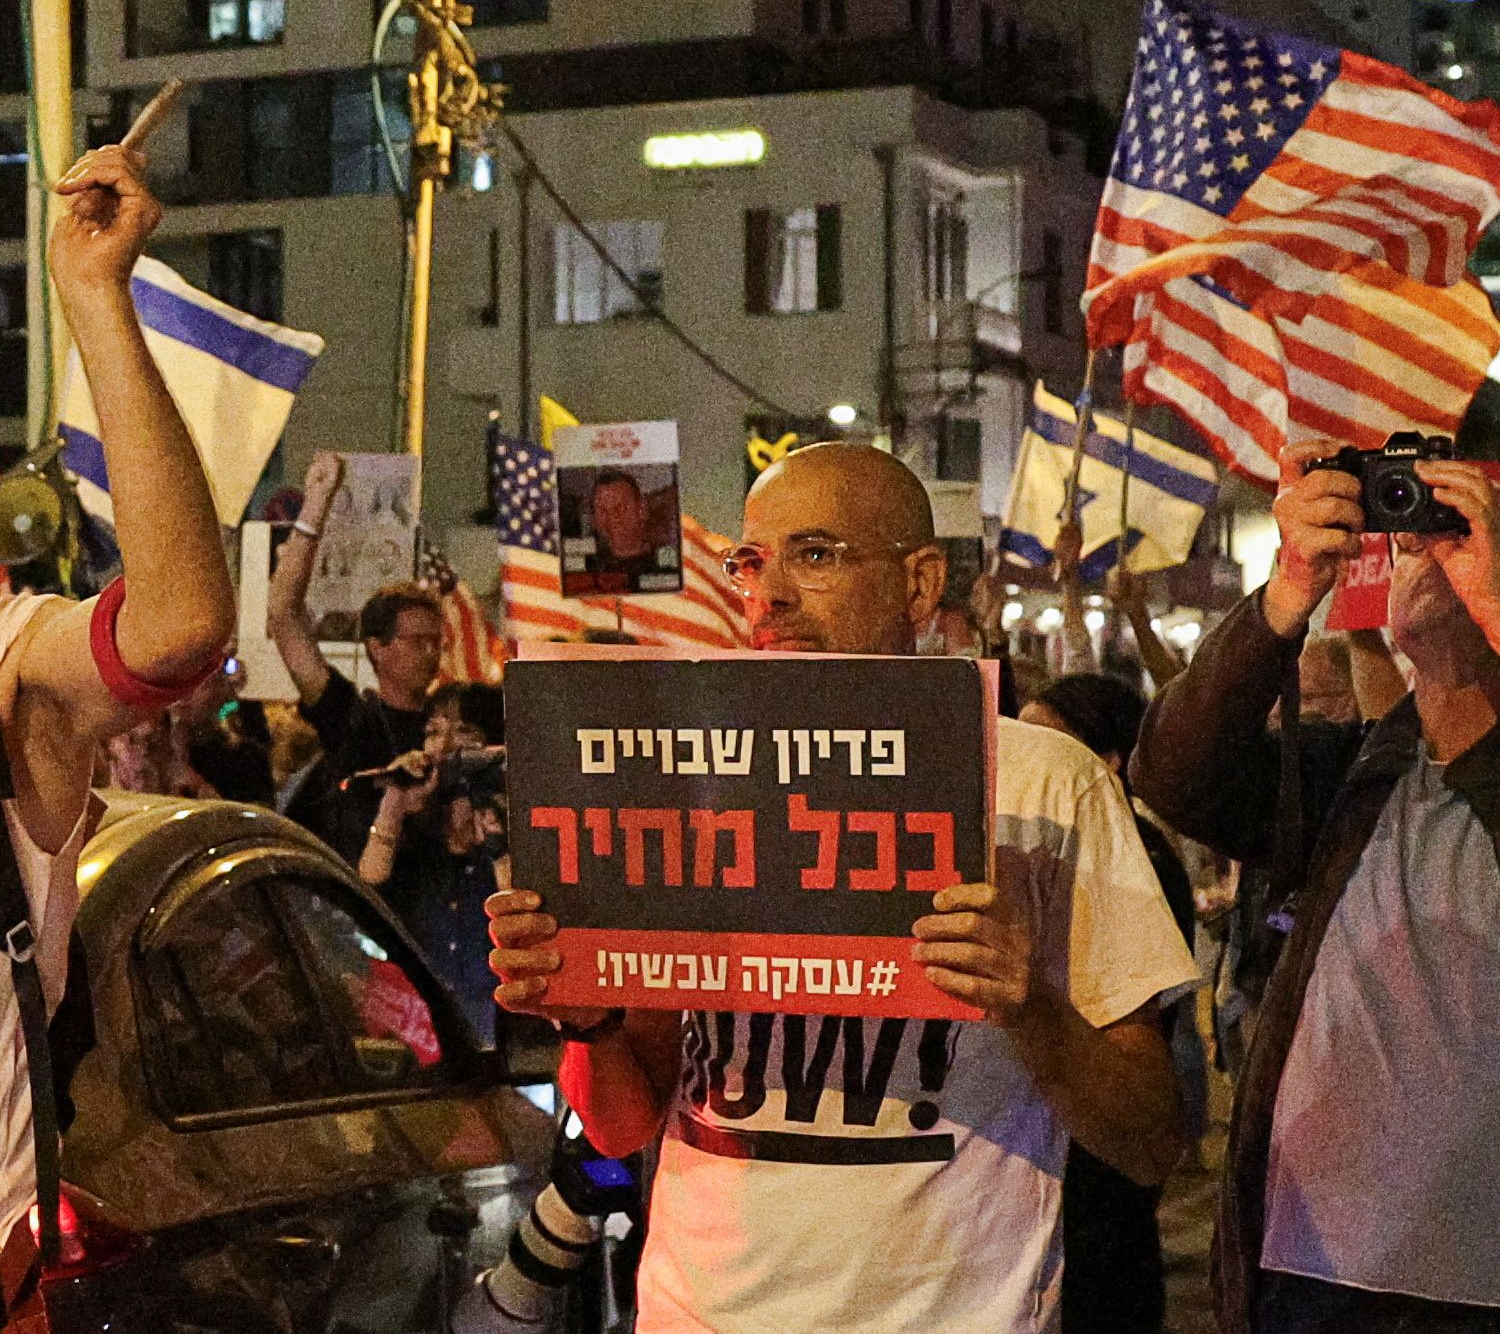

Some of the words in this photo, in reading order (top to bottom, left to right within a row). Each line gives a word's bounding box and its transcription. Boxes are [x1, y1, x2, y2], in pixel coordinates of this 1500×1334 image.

[576, 726, 754, 776] שבויים
[772, 727, 907, 785] פדיון
[531, 804, 756, 889] מחיר
[787, 793, 964, 893] בכל
[597, 949, 728, 994] עכשיו!
[742, 955, 900, 1000] #עסקה
[682, 1009, 955, 1131] OW!
